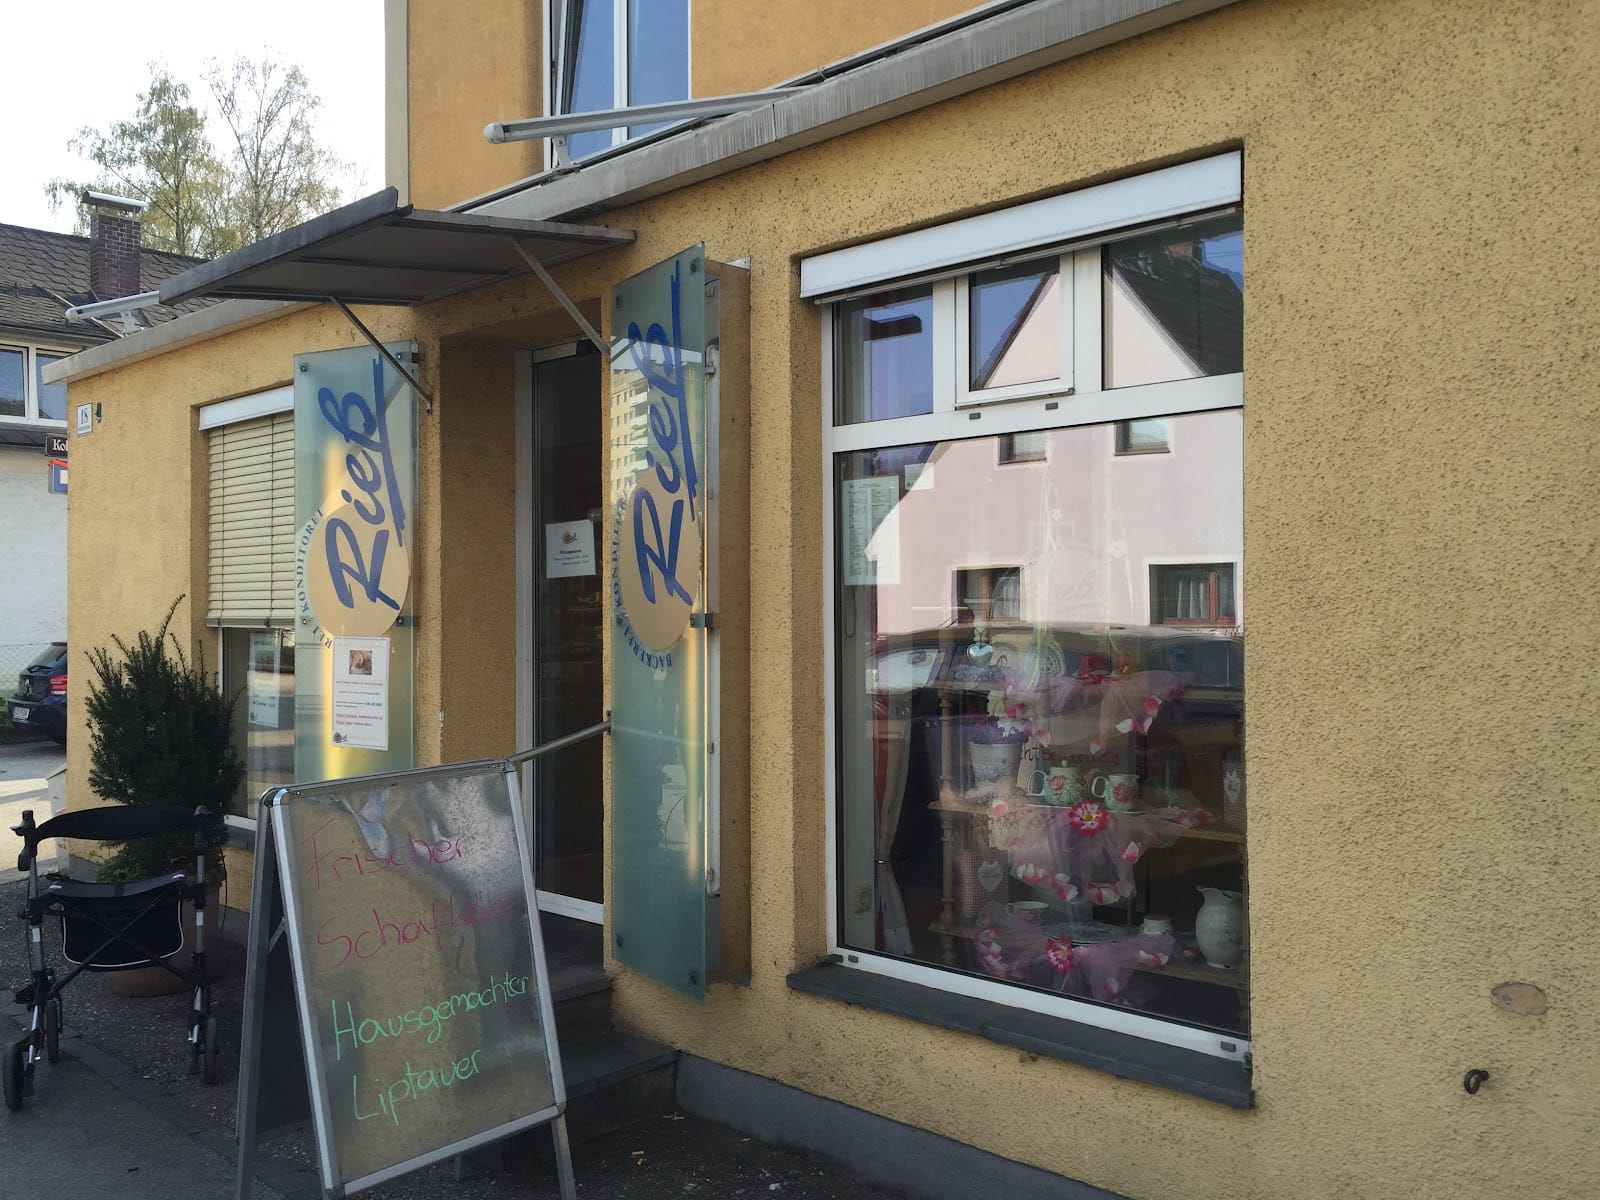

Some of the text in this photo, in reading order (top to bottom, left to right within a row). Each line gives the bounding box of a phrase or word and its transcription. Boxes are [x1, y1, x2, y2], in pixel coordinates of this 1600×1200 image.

[81, 407, 89, 425] 18
[296, 507, 324, 613] KONDITOREI
[624, 626, 672, 672] BÄCKEREI
[301, 818, 465, 891] Frischer
[332, 973, 529, 1061] Hausgemachter
[352, 1050, 481, 1126] Liptauer
